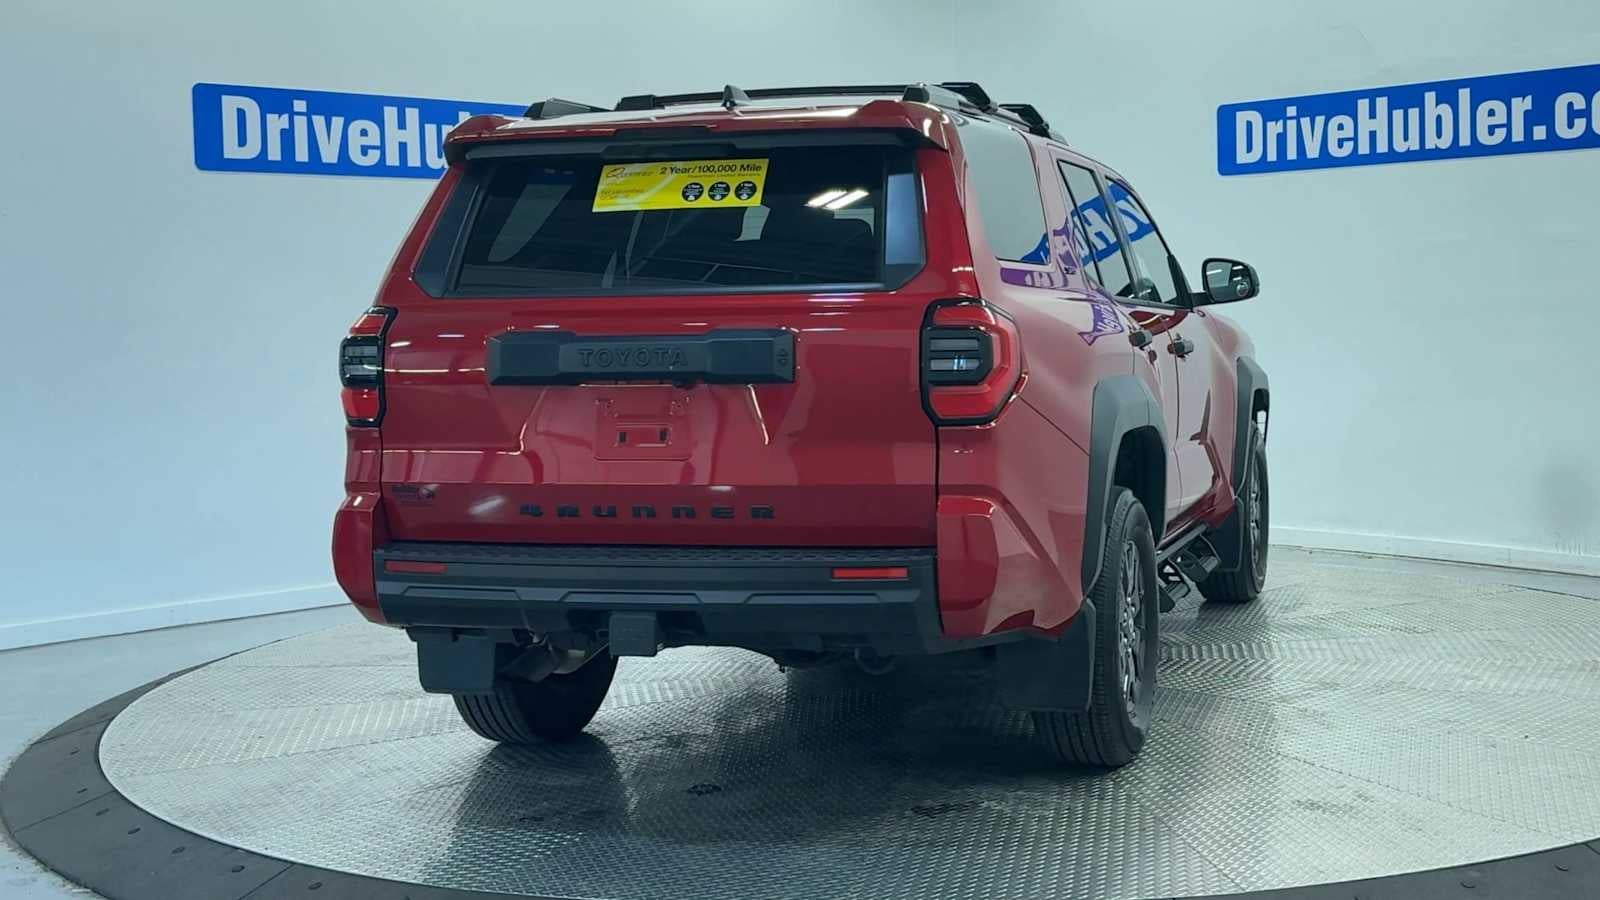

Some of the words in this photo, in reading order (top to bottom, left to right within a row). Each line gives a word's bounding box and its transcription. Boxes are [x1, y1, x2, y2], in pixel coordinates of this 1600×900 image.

[221, 94, 471, 170] DriveHu
[1235, 87, 1600, 165] DriveHubler.c
[659, 166, 667, 175] 2
[669, 164, 737, 175] Year/100,000
[739, 164, 762, 172] Mile
[578, 347, 688, 368] TOYOTA
[519, 502, 777, 519] 4RUNNER
